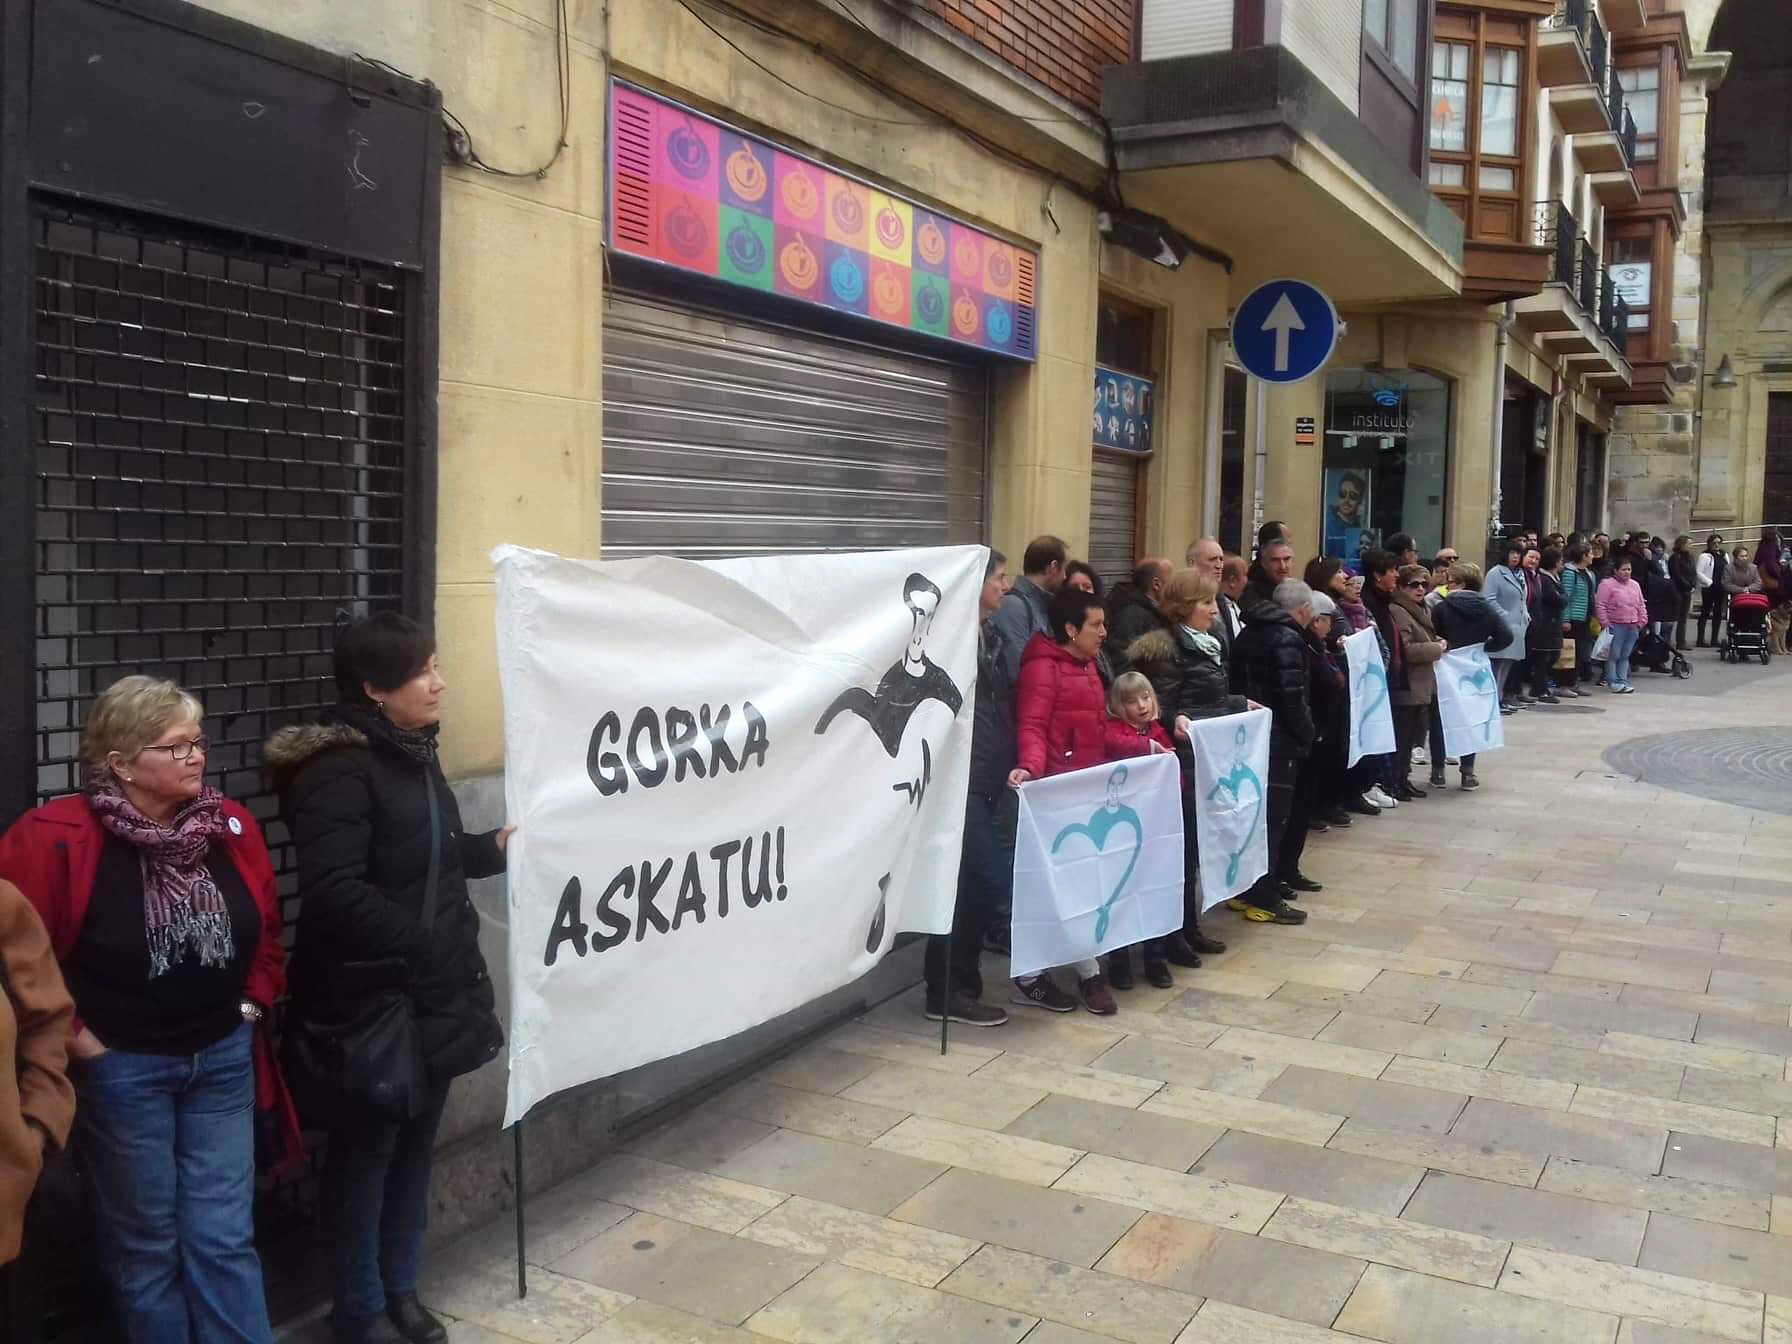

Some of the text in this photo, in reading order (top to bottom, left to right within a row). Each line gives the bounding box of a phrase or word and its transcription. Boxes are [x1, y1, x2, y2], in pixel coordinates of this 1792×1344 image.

[1352, 411, 1415, 428] instituto
[586, 701, 770, 796] GORKA
[544, 826, 788, 966] ASKATU!
